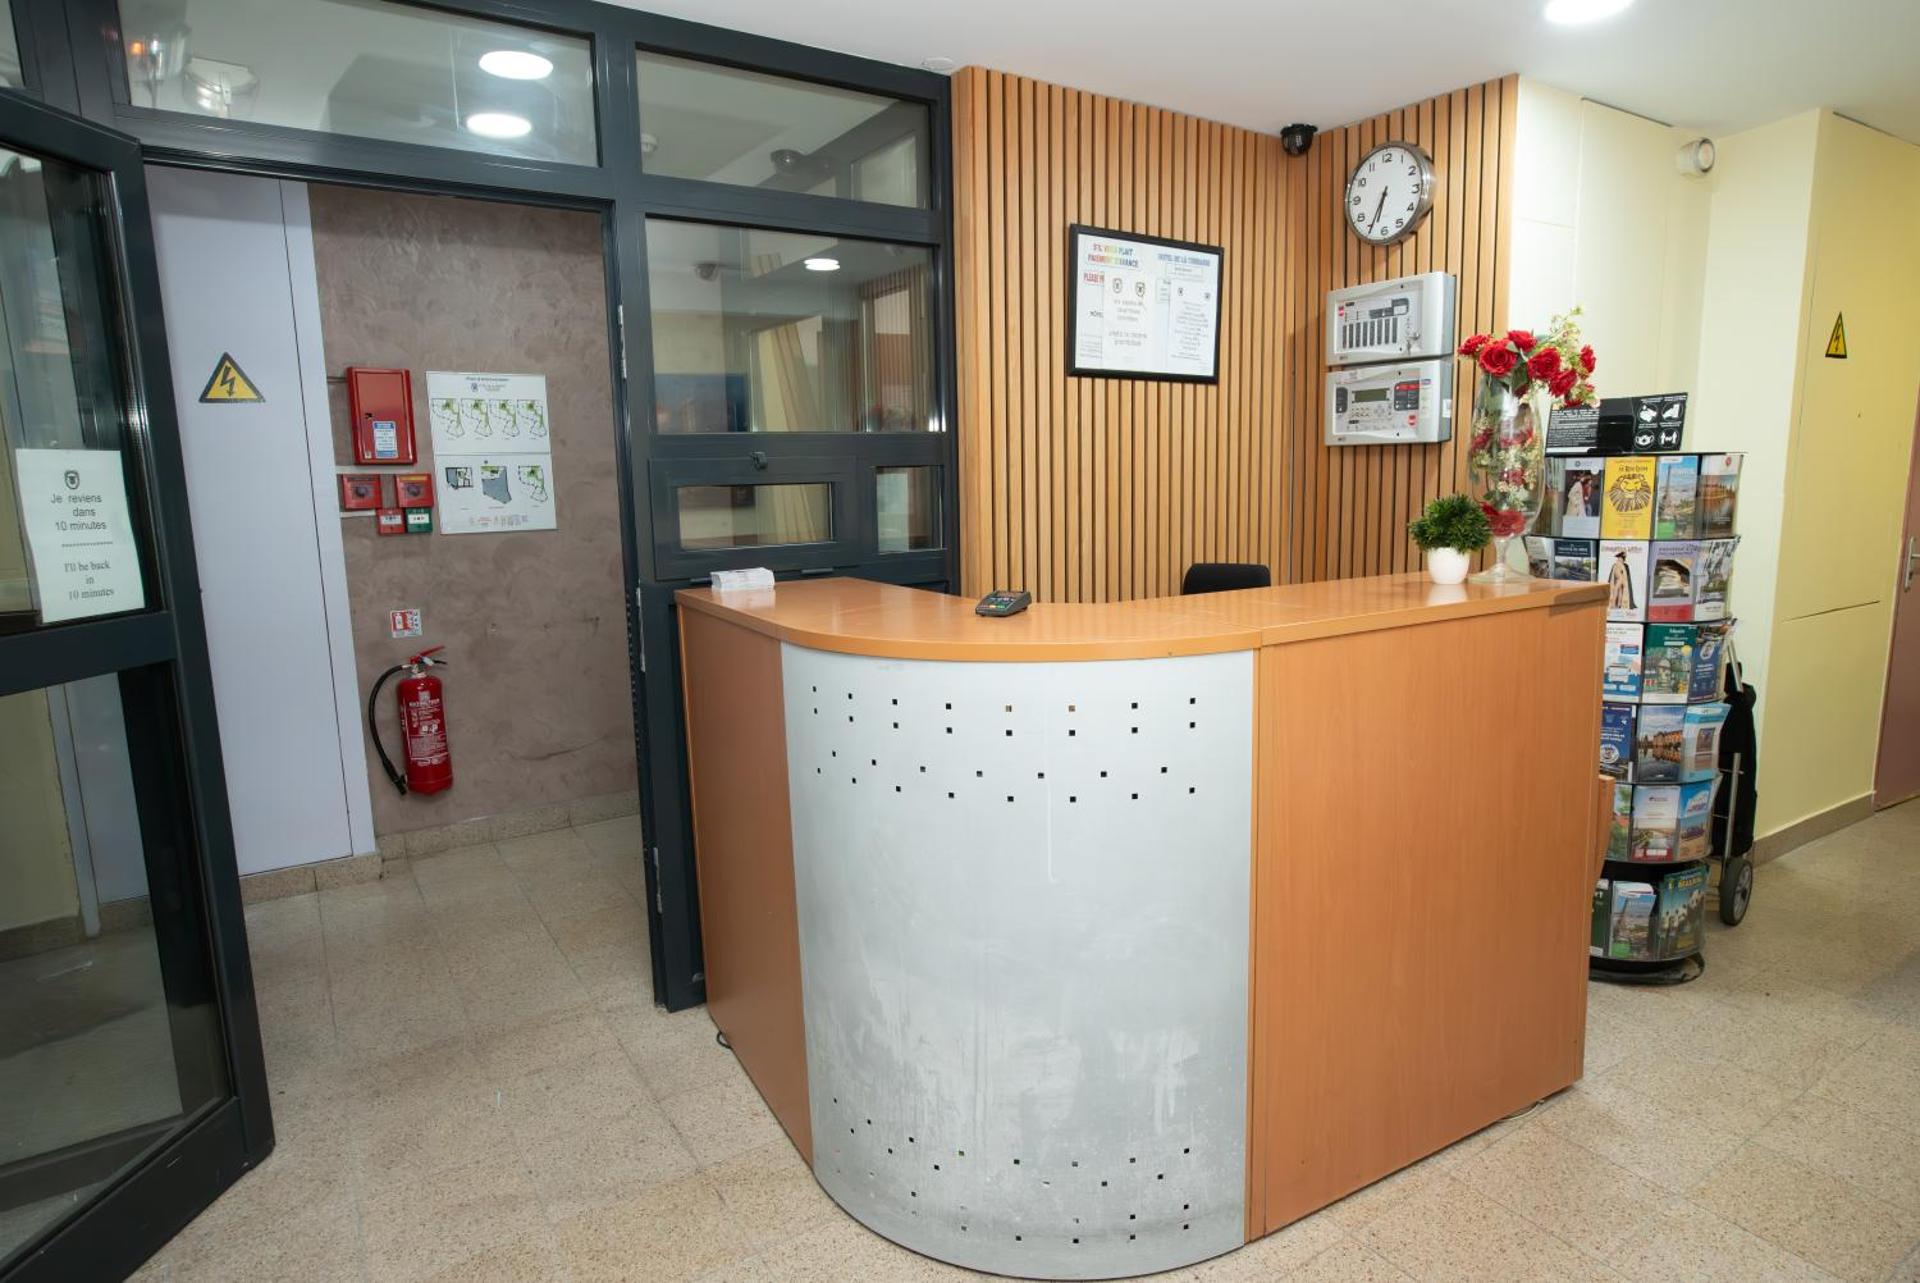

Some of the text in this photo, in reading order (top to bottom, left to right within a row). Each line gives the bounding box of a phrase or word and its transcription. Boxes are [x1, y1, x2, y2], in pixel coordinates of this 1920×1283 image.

[1381, 153, 1393, 163] 12
[1368, 163, 1376, 172] 11
[1408, 166, 1417, 176] 2
[1358, 178, 1367, 187] 10
[1411, 184, 1420, 194] 3
[1353, 196, 1361, 205] 9
[1406, 202, 1414, 211] 4
[1357, 213, 1366, 222] 8
[1395, 218, 1404, 228] 5
[1380, 227, 1389, 236] 6
[50, 493, 102, 504] Je reviens
[72, 506, 96, 518] dans
[55, 519, 107, 531] 10 minutes
[78, 561, 90, 572] be
[90, 560, 111, 571] back
[85, 576, 95, 585] in
[69, 588, 115, 600] 10 minutes
